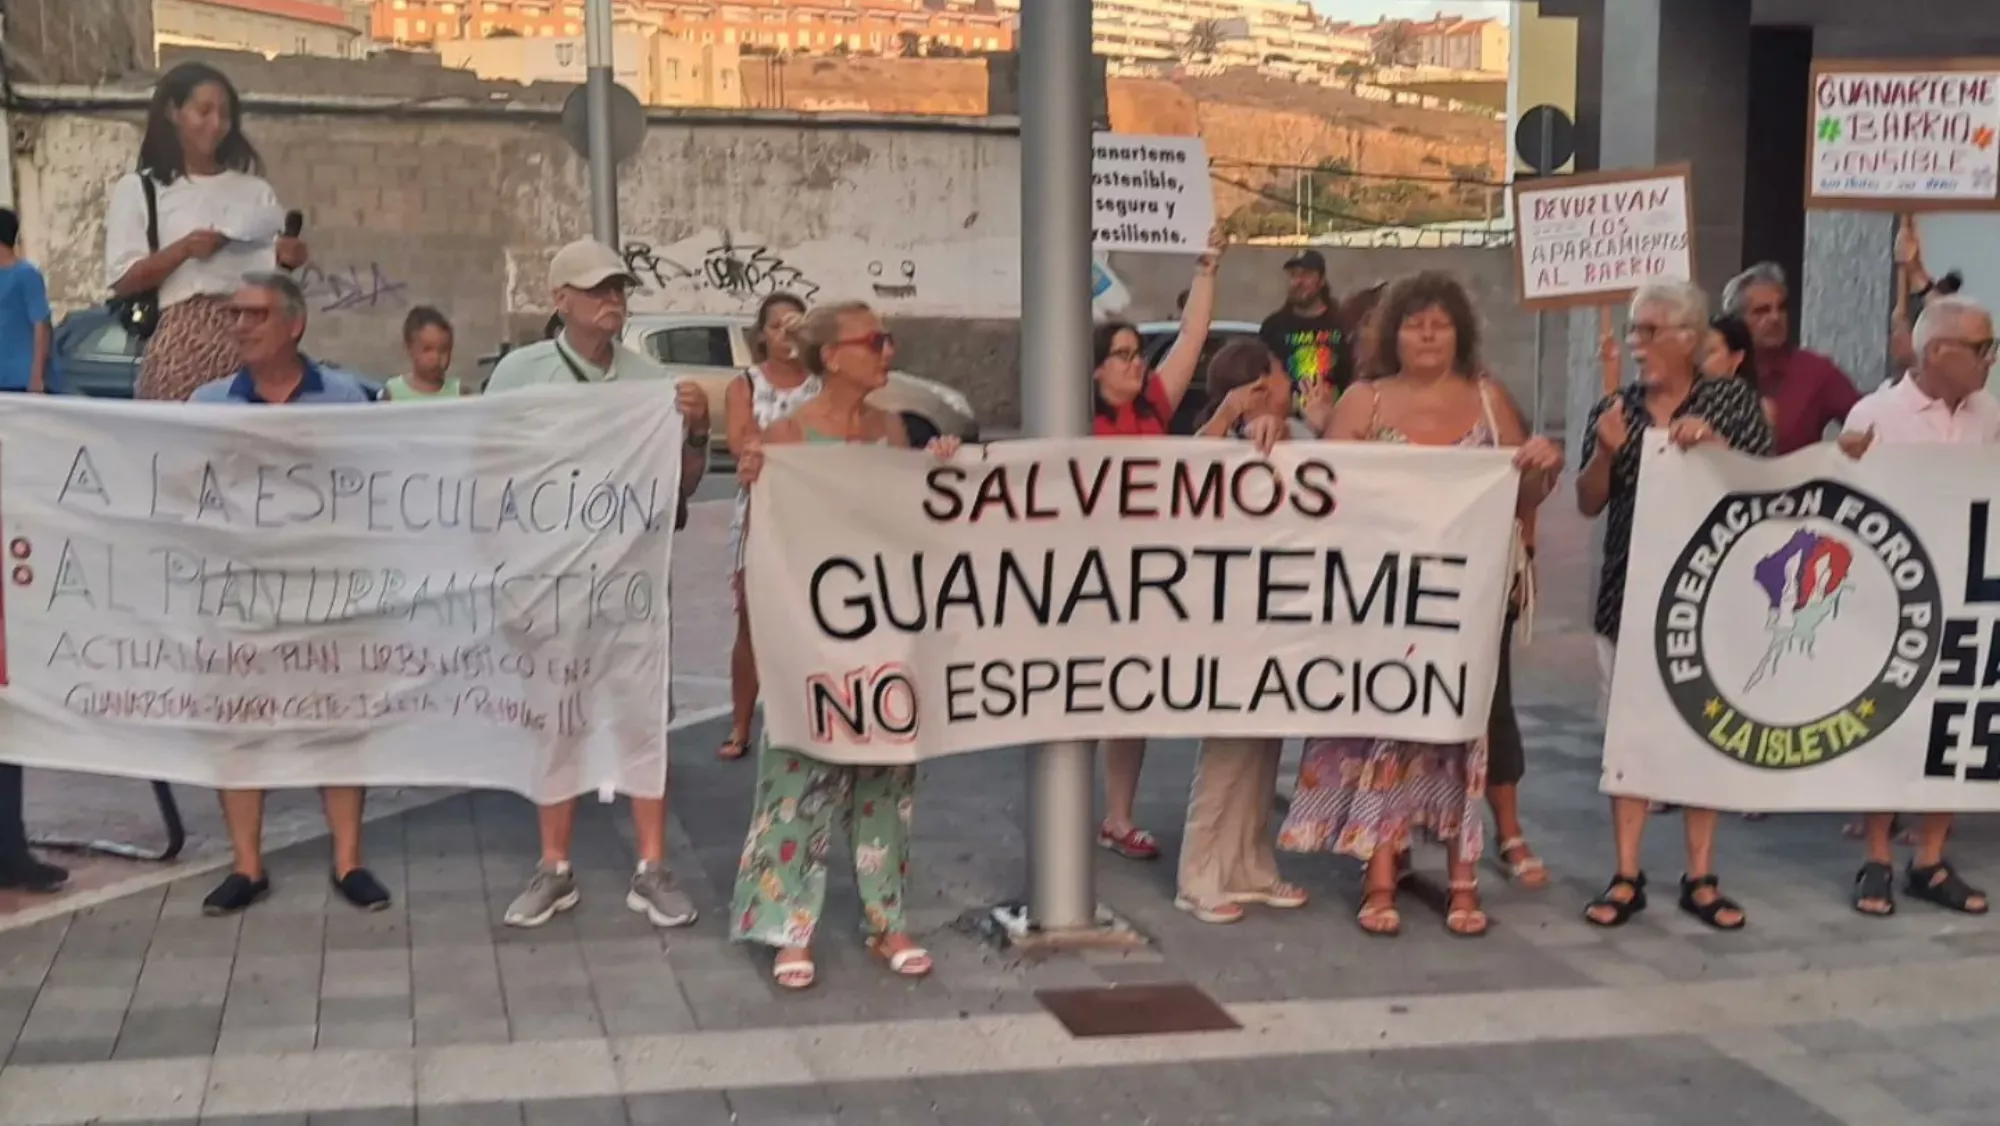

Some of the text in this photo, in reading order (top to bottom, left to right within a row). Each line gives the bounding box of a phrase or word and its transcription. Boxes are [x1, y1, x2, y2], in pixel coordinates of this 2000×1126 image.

[1818, 75, 1995, 109] GUANARTEME
[1848, 111, 1970, 144] BARRIO
[1092, 144, 1186, 163] anarteme
[1821, 149, 1966, 175] SENSIBLE
[1092, 168, 1184, 193] ostenible,
[1096, 198, 1175, 219] segura y
[1533, 186, 1669, 221] DEVUELVAN
[1588, 216, 1629, 237] LOS
[1531, 231, 1688, 264] APARCAMIENTOS
[1538, 256, 1665, 289] AL BARRIO
[58, 445, 110, 506] A
[921, 457, 1339, 524] SALVEMOS
[1832, 495, 1926, 591] FORO
[48, 538, 138, 613] AL
[1667, 487, 1823, 685] FEDERACIÓN
[809, 547, 1468, 642] GUANARTEME
[1881, 602, 1932, 689] POR
[806, 644, 1467, 744] NO ESPECULACIÓN
[1708, 708, 1871, 766] LA ISLETA
